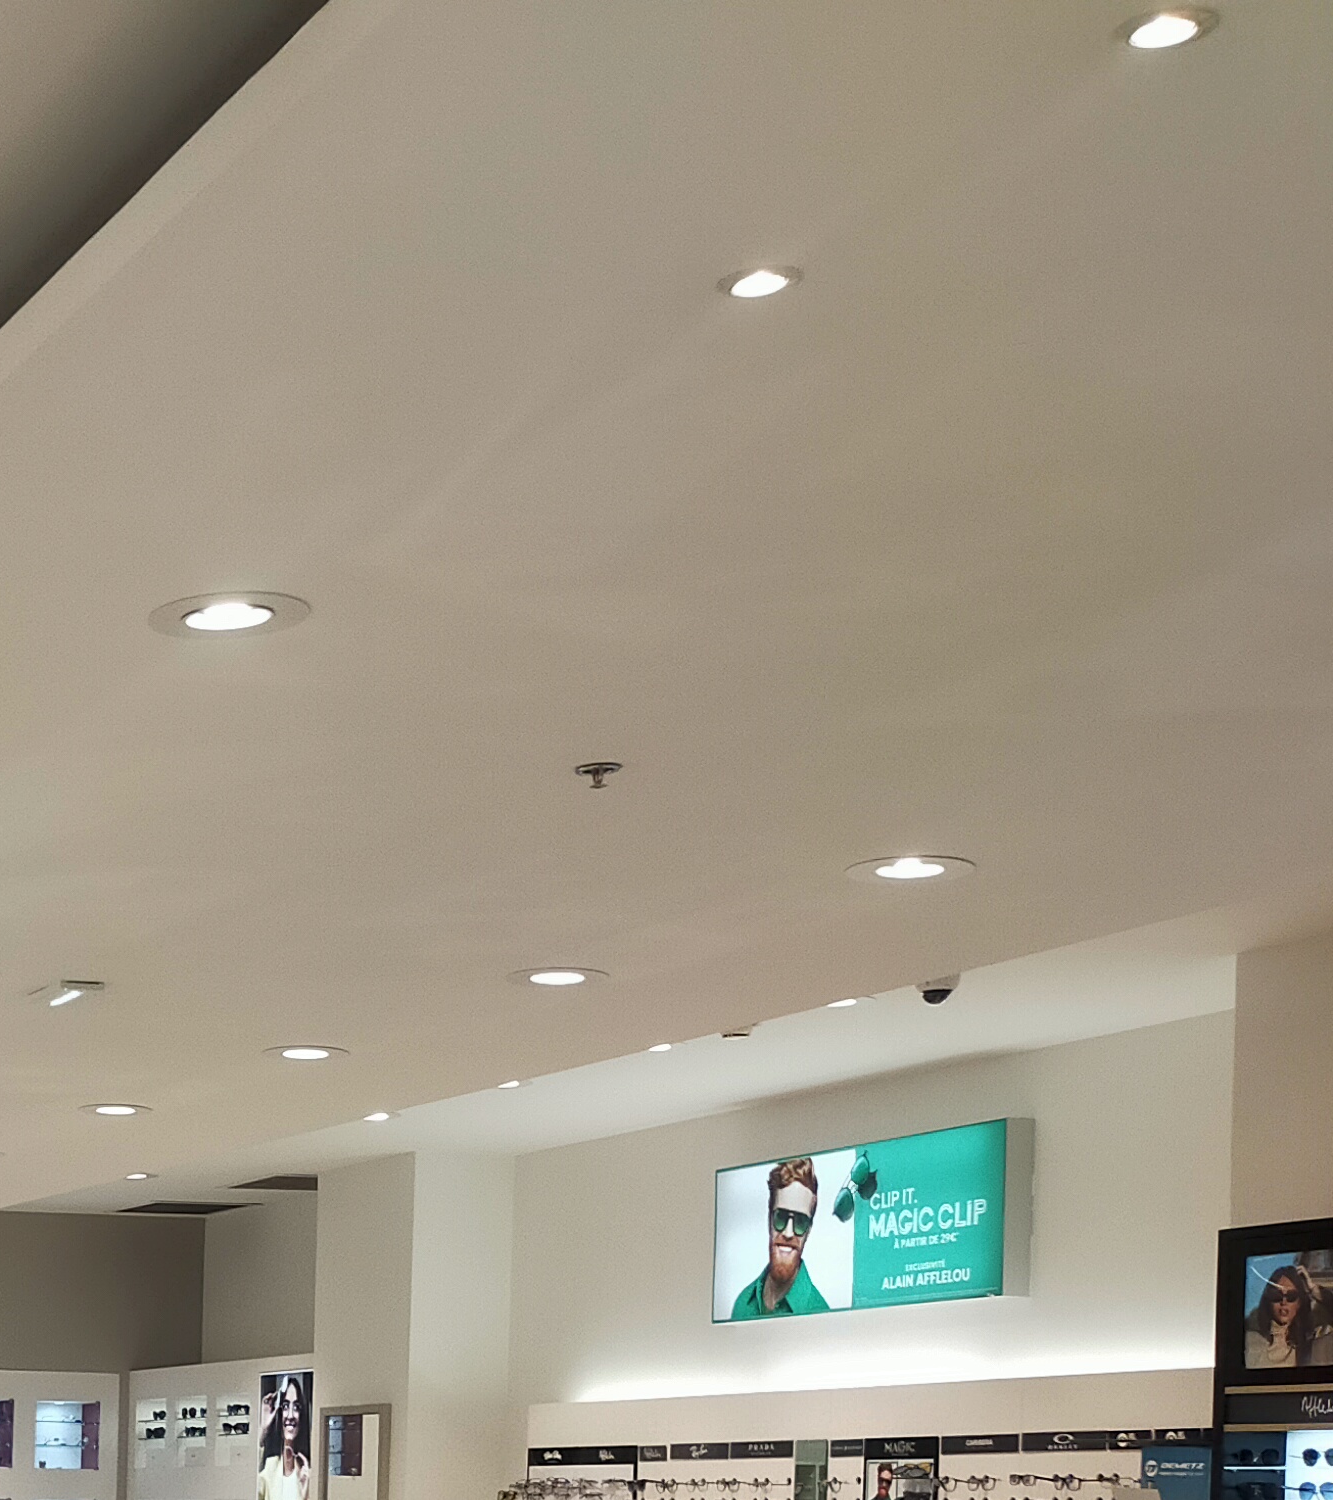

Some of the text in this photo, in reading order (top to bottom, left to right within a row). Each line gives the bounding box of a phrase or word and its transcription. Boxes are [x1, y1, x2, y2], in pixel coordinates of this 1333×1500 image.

[870, 1190, 900, 1210] CLIP
[868, 1198, 987, 1240] MAGIC CLIP
[901, 1236, 928, 1248] PARTIR
[929, 1234, 939, 1245] DE
[881, 1267, 971, 1290] ALAIN AFFLELOU
